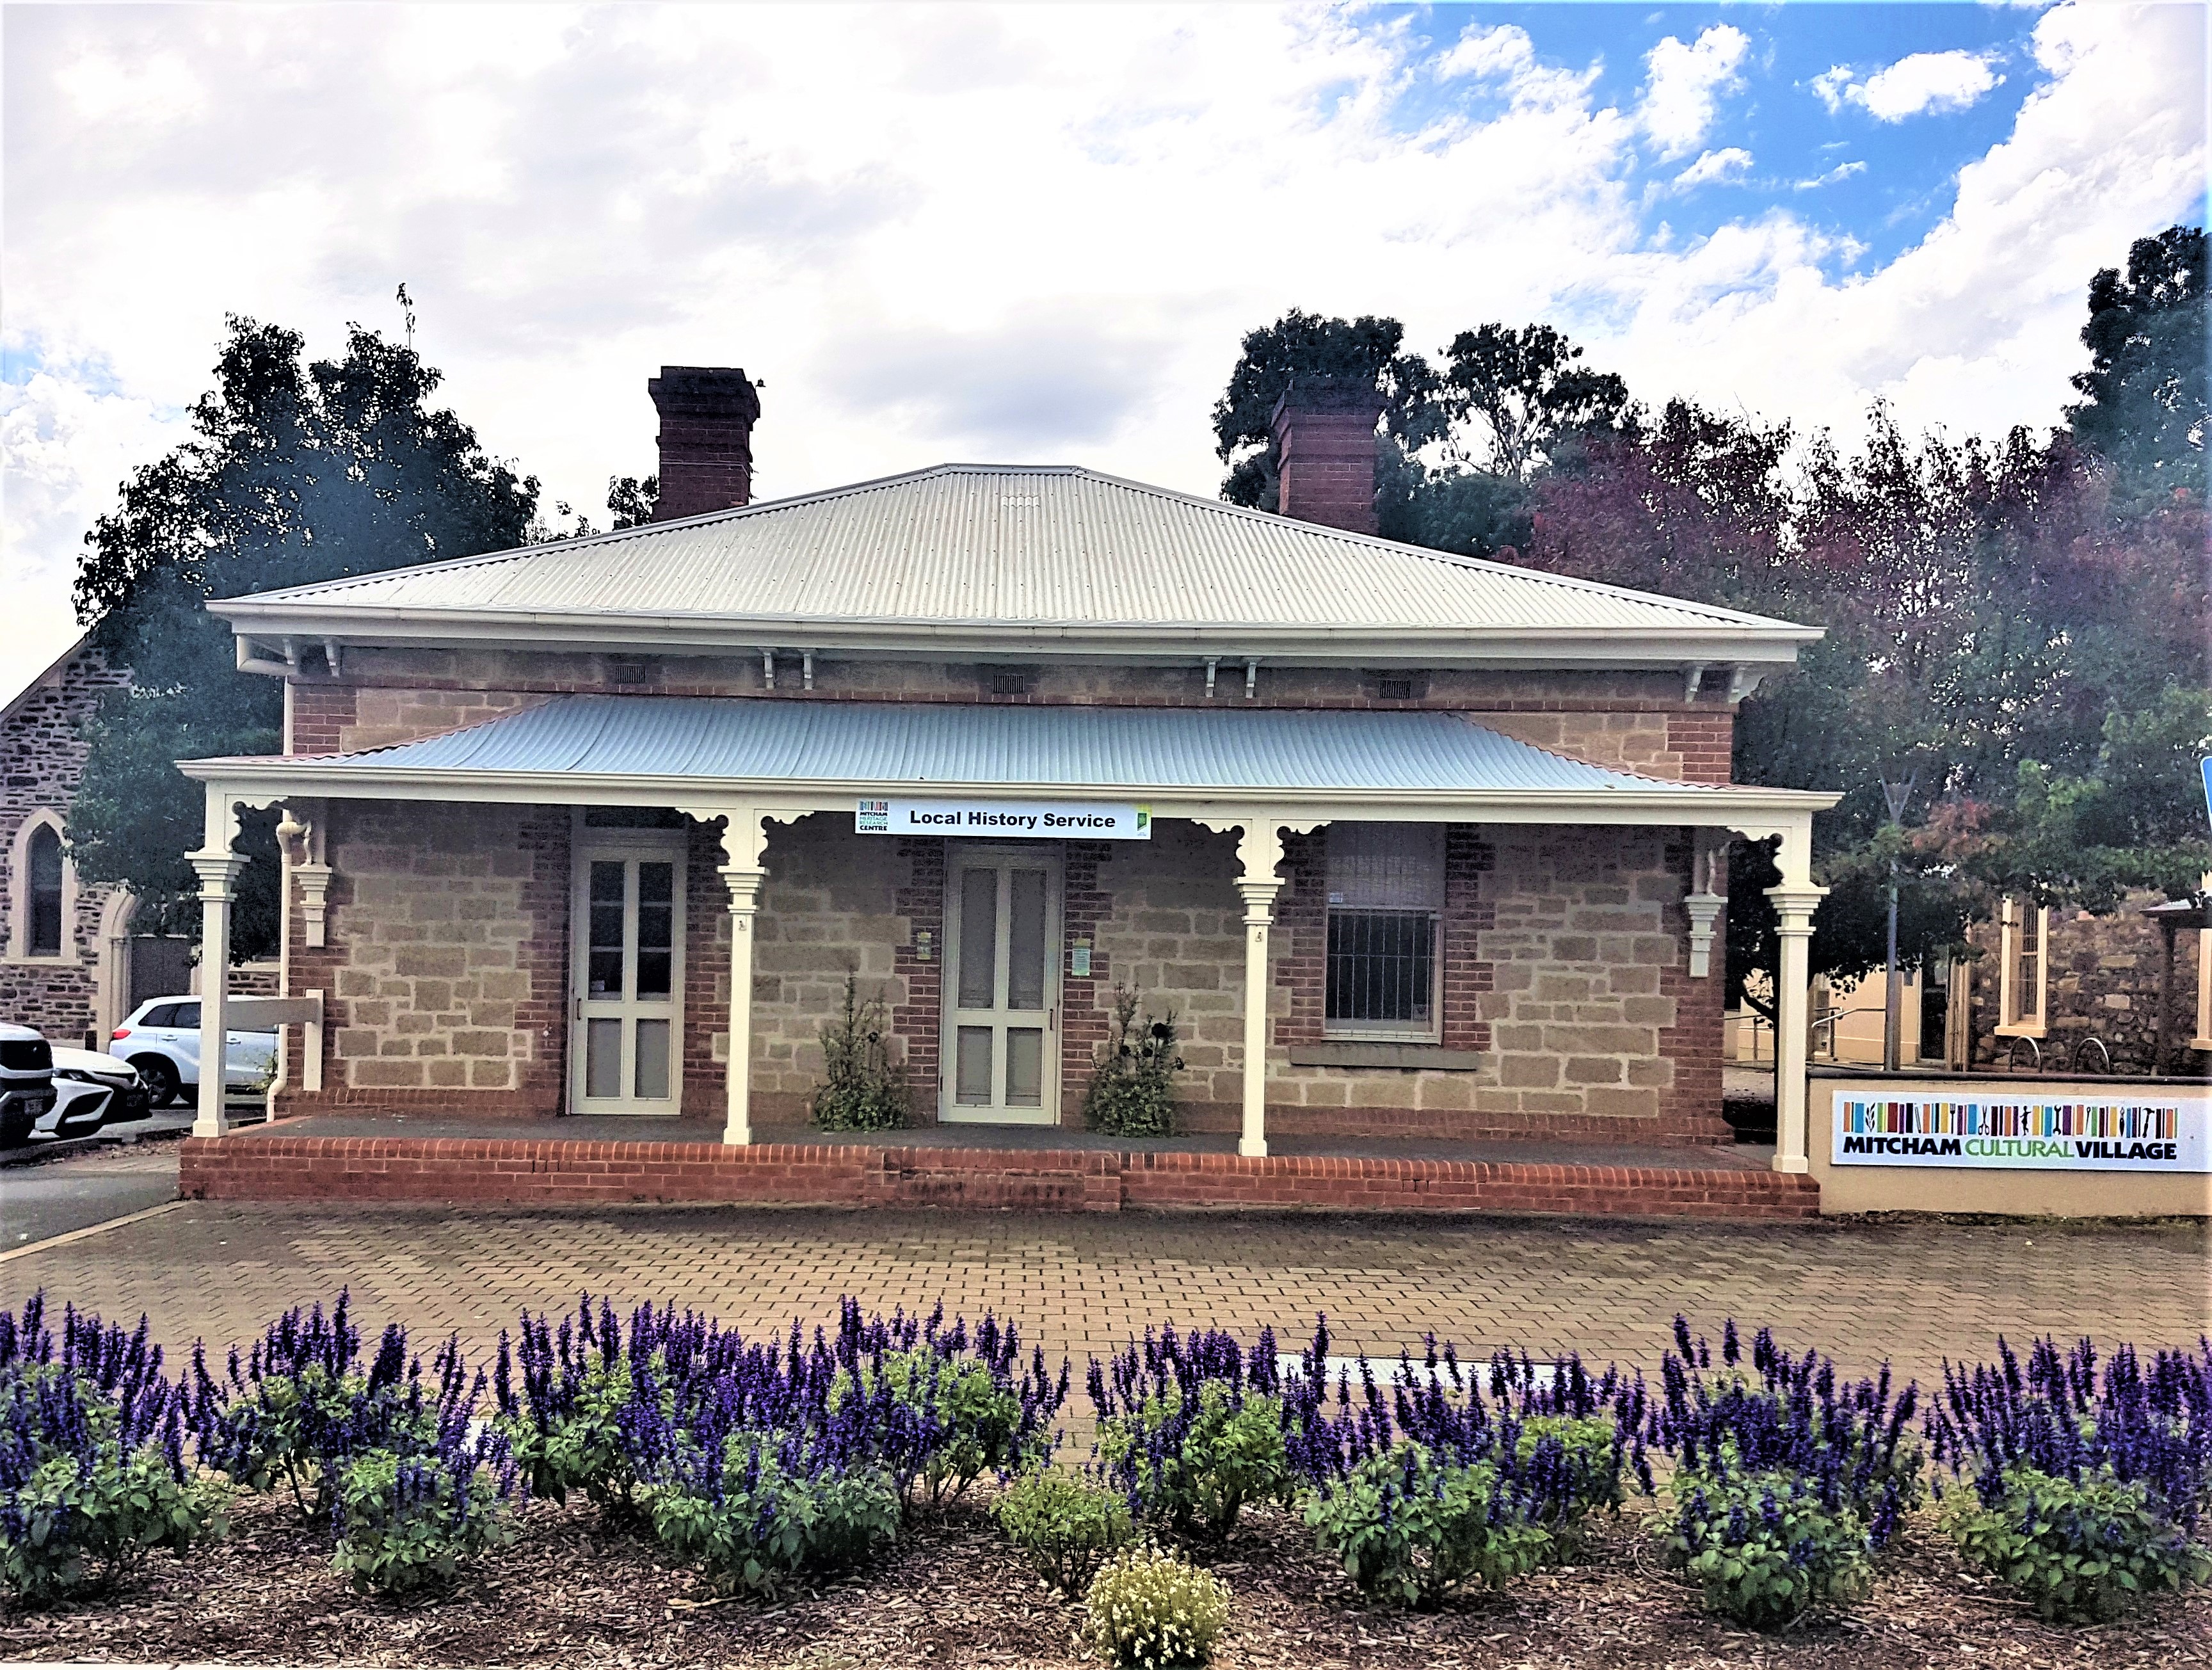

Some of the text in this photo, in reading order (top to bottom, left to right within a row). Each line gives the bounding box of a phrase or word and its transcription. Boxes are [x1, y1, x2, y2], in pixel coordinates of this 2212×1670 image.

[910, 810, 1116, 830] Local History Service
[1843, 1136, 2177, 1160] MITCHAM CULTURAL VILLAGE
